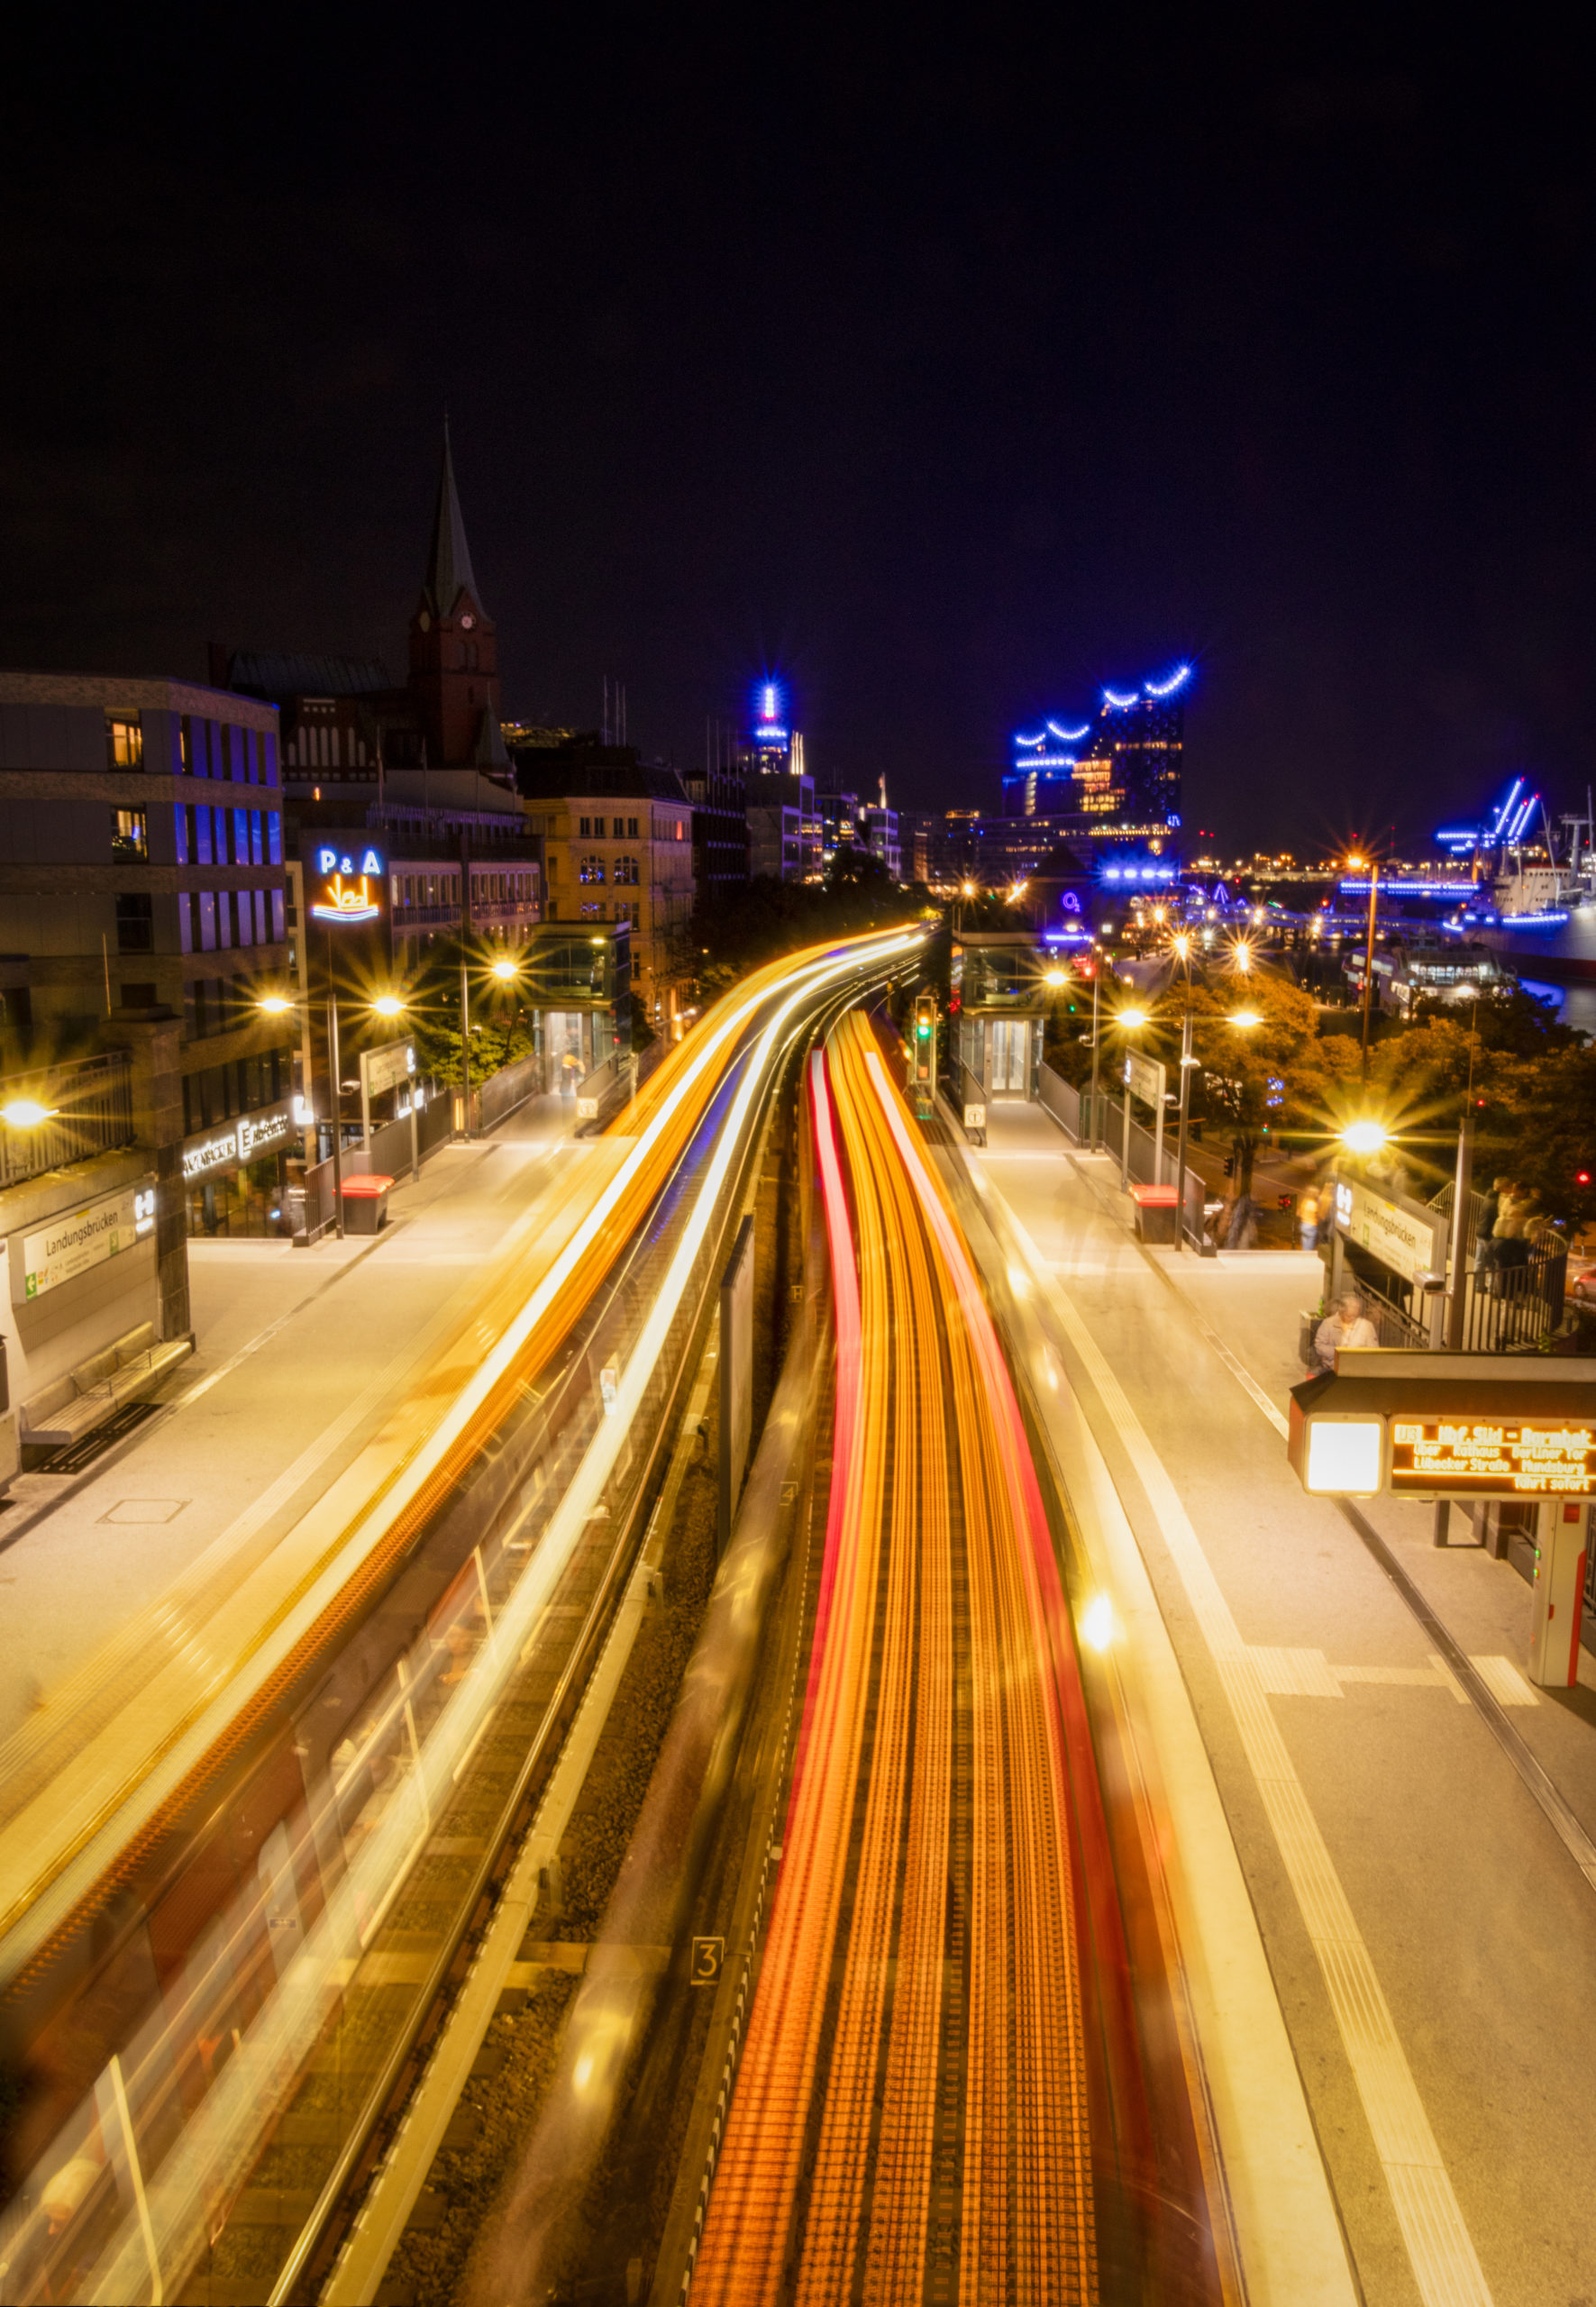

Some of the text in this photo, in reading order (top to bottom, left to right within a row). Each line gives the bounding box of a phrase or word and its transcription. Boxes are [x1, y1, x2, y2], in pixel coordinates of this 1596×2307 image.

[320, 850, 380, 874] P & A
[46, 1211, 118, 1257] Landungsbrücken
[1363, 1200, 1416, 1248] Landungsbrücken
[1397, 1426, 1420, 1443] U3
[1521, 1427, 1591, 1446] Barmbek
[1453, 1444, 1500, 1457] Rathaus
[1512, 1445, 1563, 1459] Berliner
[1566, 1447, 1587, 1460] Tor
[1414, 1455, 1585, 1475] Lübecker Straße Mundsburg
[1550, 1478, 1589, 1491] sofort
[698, 1944, 717, 1976] 3
